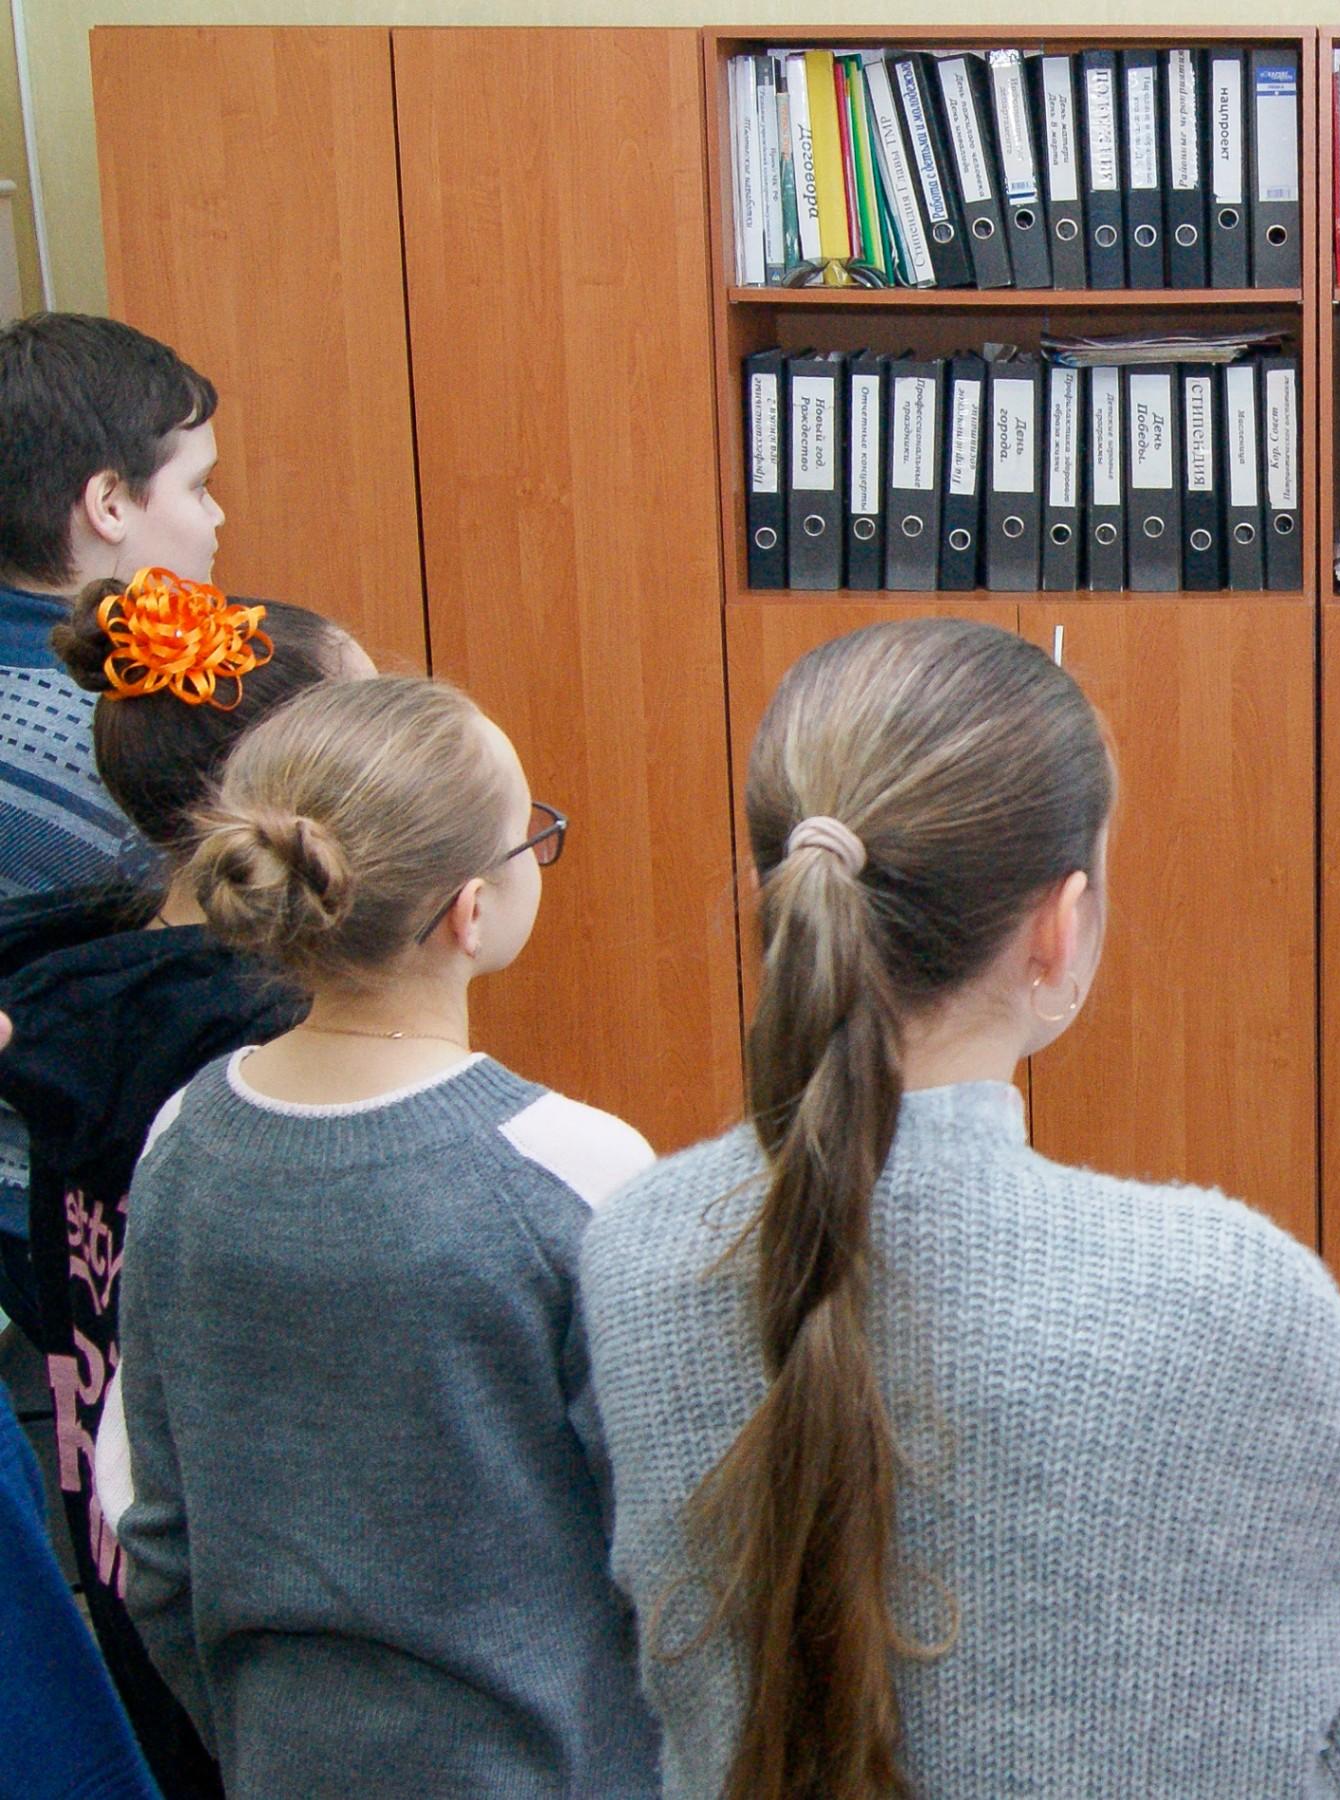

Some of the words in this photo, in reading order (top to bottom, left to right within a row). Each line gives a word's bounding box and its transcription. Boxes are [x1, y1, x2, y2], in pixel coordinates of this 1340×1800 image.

[900, 61, 923, 121] молодежью
[948, 99, 961, 122] День
[1047, 93, 1057, 118] День
[1058, 95, 1068, 120] День
[880, 115, 898, 147] ТМР
[1060, 123, 1070, 163] матери
[1219, 87, 1230, 160] нацпроект
[892, 150, 908, 192] Главы
[916, 131, 935, 173] детьми
[954, 126, 970, 174] инвалида
[1050, 131, 1060, 166] марта
[798, 124, 820, 220] Договора
[926, 180, 946, 220] Работа
[899, 194, 927, 268] Стипендия
[752, 377, 766, 485] Профессиональные
[800, 396, 812, 473] Рождество
[815, 398, 827, 442] Новый
[860, 386, 872, 449] Отчетные
[901, 400, 914, 465] праздники.
[912, 379, 926, 489] Профессиональные
[997, 408, 1012, 463] города.
[1015, 417, 1027, 455] День
[1052, 403, 1063, 438] образа
[1062, 374, 1075, 453] Профилактика
[1105, 393, 1116, 438] Детские
[1136, 403, 1150, 465] Победы.
[1152, 412, 1165, 450] День
[1269, 407, 1280, 442] Совет
[814, 446, 826, 470] год.
[1237, 410, 1247, 464] Масленица
[858, 452, 870, 512] концерты
